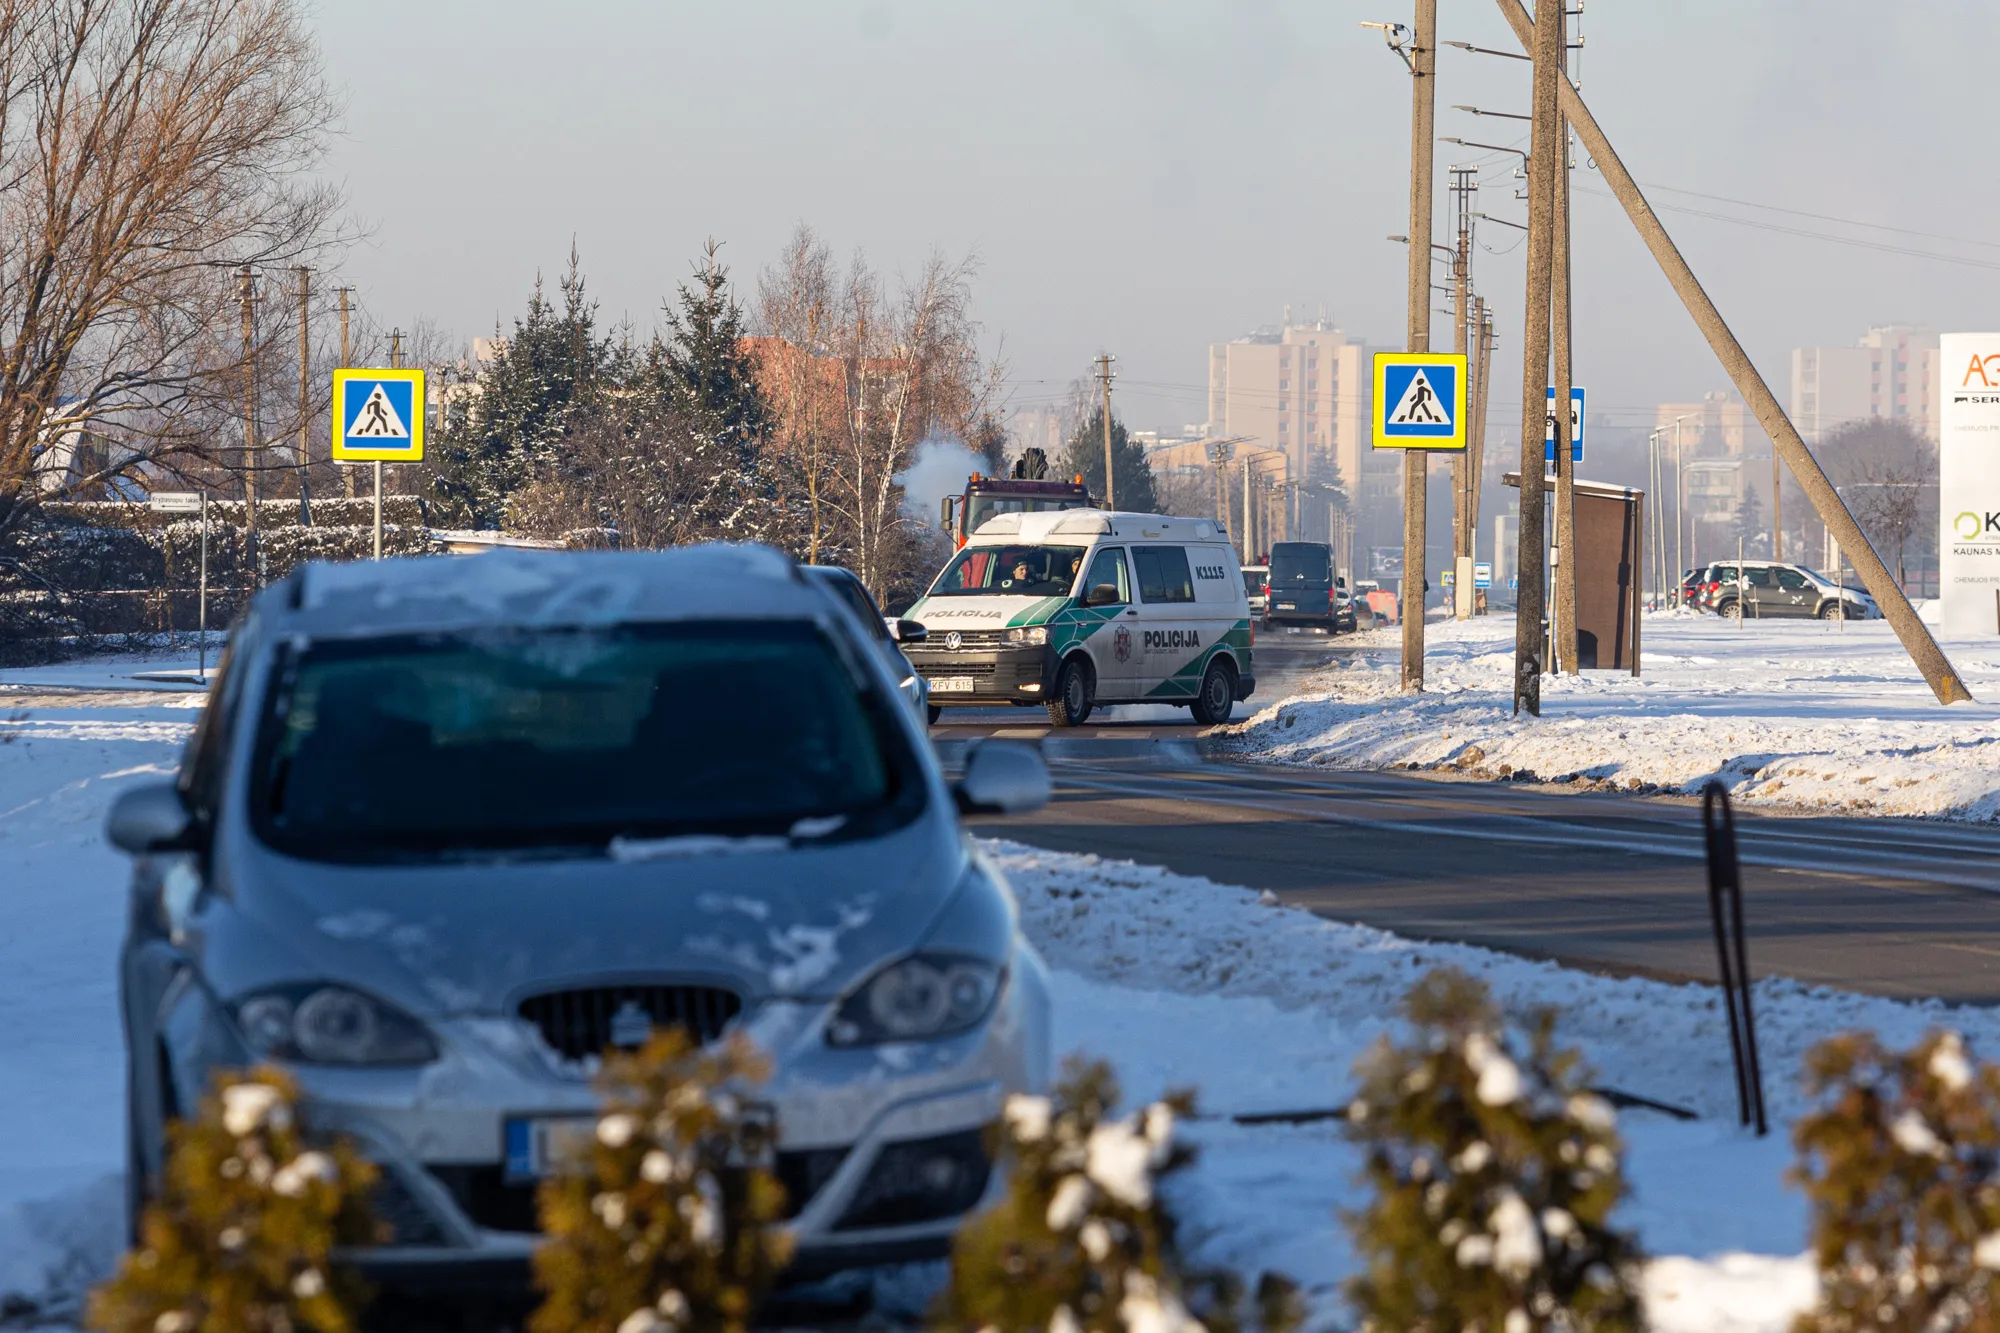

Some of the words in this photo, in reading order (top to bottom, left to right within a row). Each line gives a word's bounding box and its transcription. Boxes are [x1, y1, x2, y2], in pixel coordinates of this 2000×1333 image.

[1971, 396, 2000, 404] SER
[1953, 547, 1992, 556] KAUNAS
[1195, 565, 1225, 580] K1115
[922, 610, 1003, 619] POLICIJA
[1144, 630, 1200, 648] POLICIJA
[931, 681, 950, 691] KFV
[955, 681, 972, 690] 615
